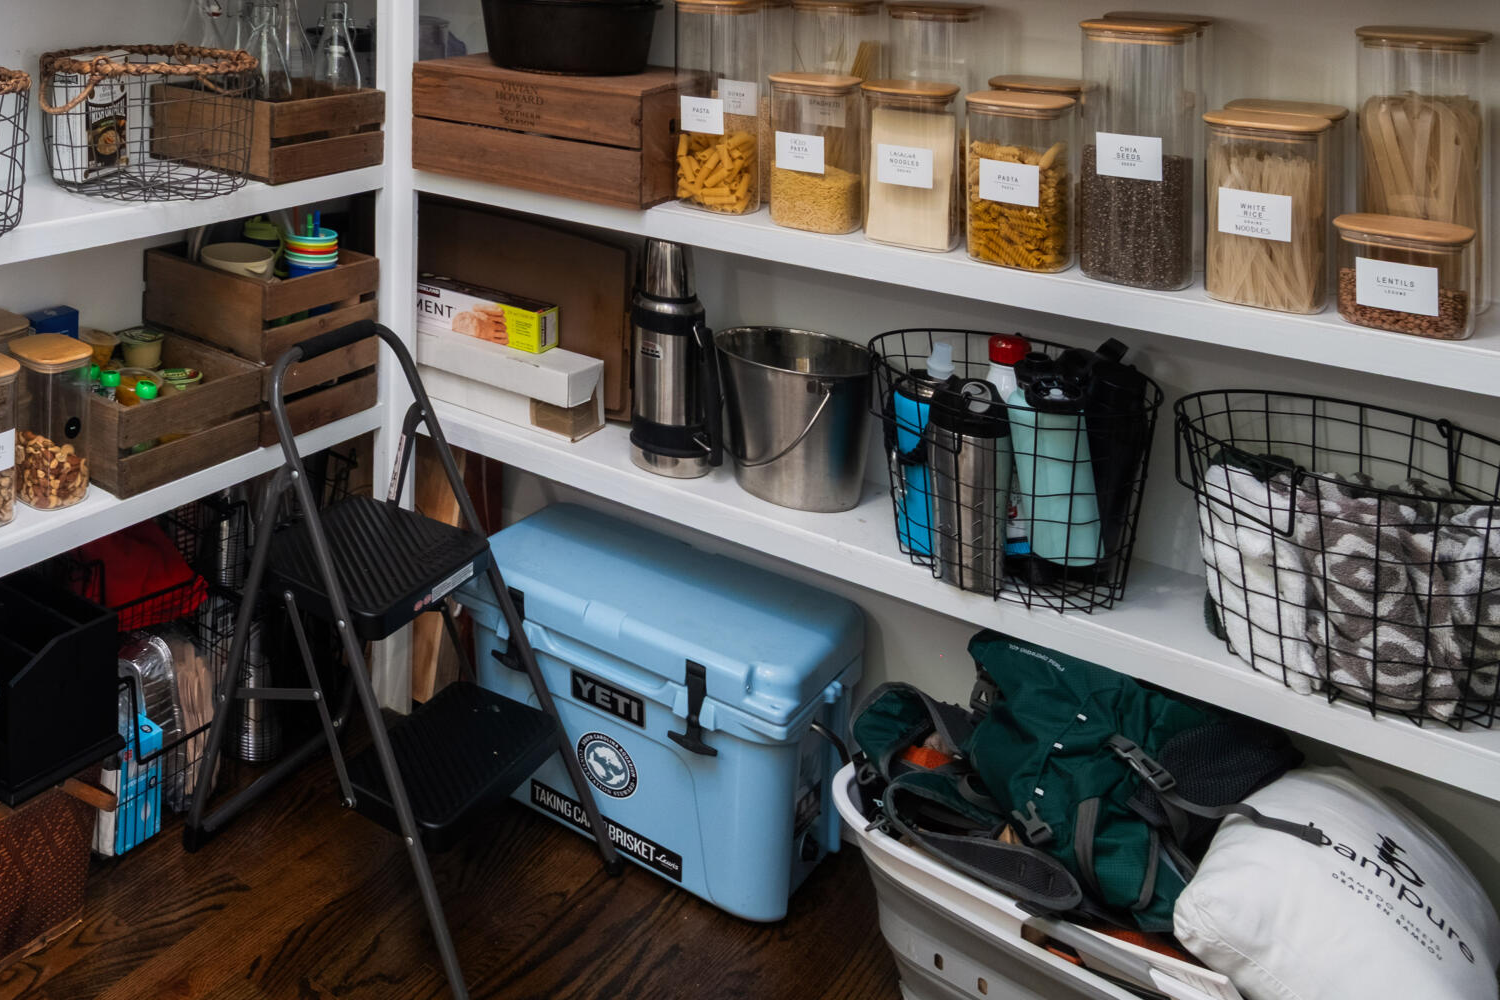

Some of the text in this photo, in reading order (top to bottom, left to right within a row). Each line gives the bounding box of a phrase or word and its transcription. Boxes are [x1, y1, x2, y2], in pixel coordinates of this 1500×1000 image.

[1119, 146, 1138, 154] CHIA
[1116, 152, 1141, 161] SEEDS
[889, 158, 920, 167] NOODLES
[997, 174, 1019, 183] PASTA
[1241, 202, 1267, 212] WHITE
[1243, 210, 1264, 219] RICE
[1235, 224, 1271, 235] NOODLES
[1376, 276, 1415, 288] LENTILS
[576, 676, 638, 721] YETI
[581, 734, 636, 778] SOUTH CAROLINA AQUARIUM
[533, 784, 573, 818] TAKING
[608, 821, 656, 862] BRISKET
[1340, 870, 1441, 951] BAMBOO SHEETS
[1332, 872, 1443, 961] DRAPS EN BAMBOU
